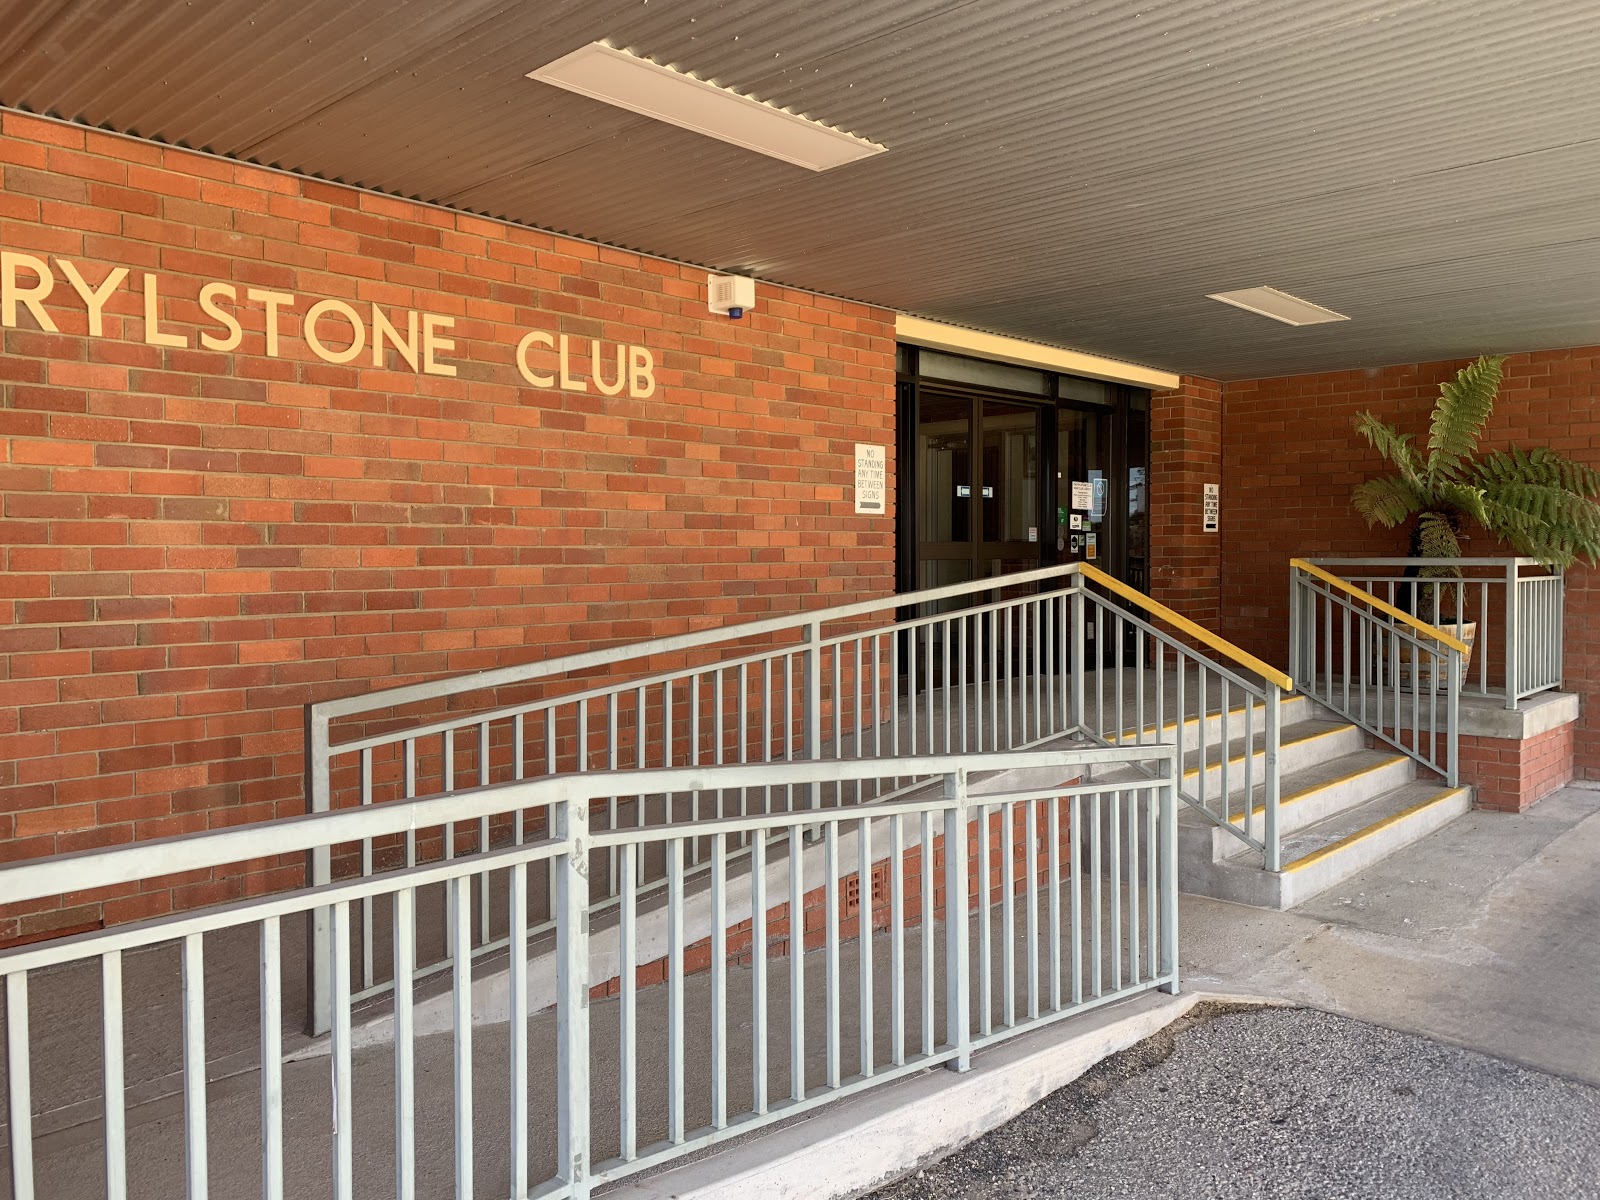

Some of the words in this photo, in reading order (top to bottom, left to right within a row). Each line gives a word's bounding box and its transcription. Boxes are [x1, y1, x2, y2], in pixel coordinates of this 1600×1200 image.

[0, 251, 457, 377] RYLSTONE
[516, 331, 656, 398] CLUB
[866, 450, 874, 458] NO
[858, 459, 884, 469] STANDING
[858, 470, 868, 478] ANY
[870, 470, 882, 479] TIME
[858, 480, 884, 489] BETWEEN
[862, 490, 880, 499] SIGNS
